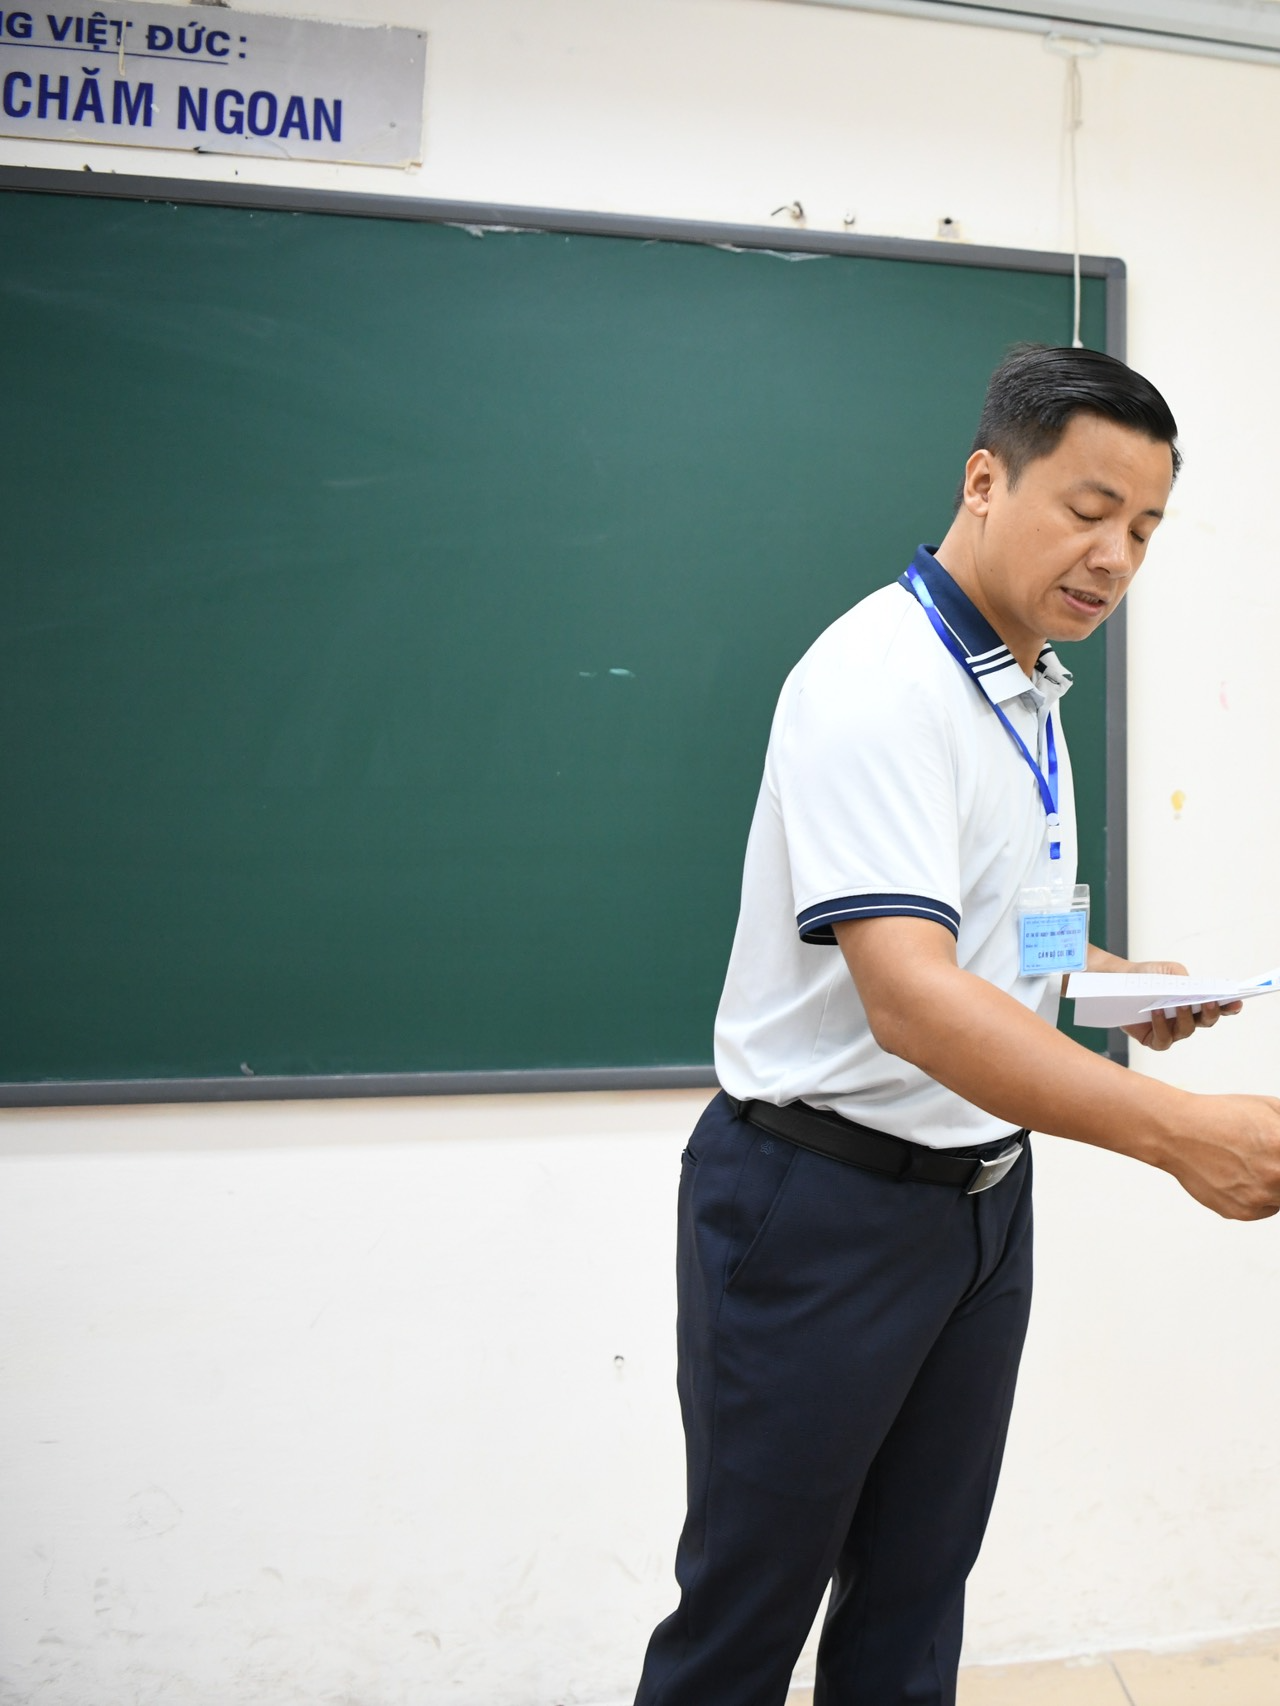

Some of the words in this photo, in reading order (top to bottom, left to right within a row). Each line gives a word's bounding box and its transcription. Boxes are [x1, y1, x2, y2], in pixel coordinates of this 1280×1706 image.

[0, 11, 33, 38] G
[46, 11, 133, 51] VIỆT
[3, 66, 154, 127] CHĂM
[177, 85, 342, 143] NGOAN
